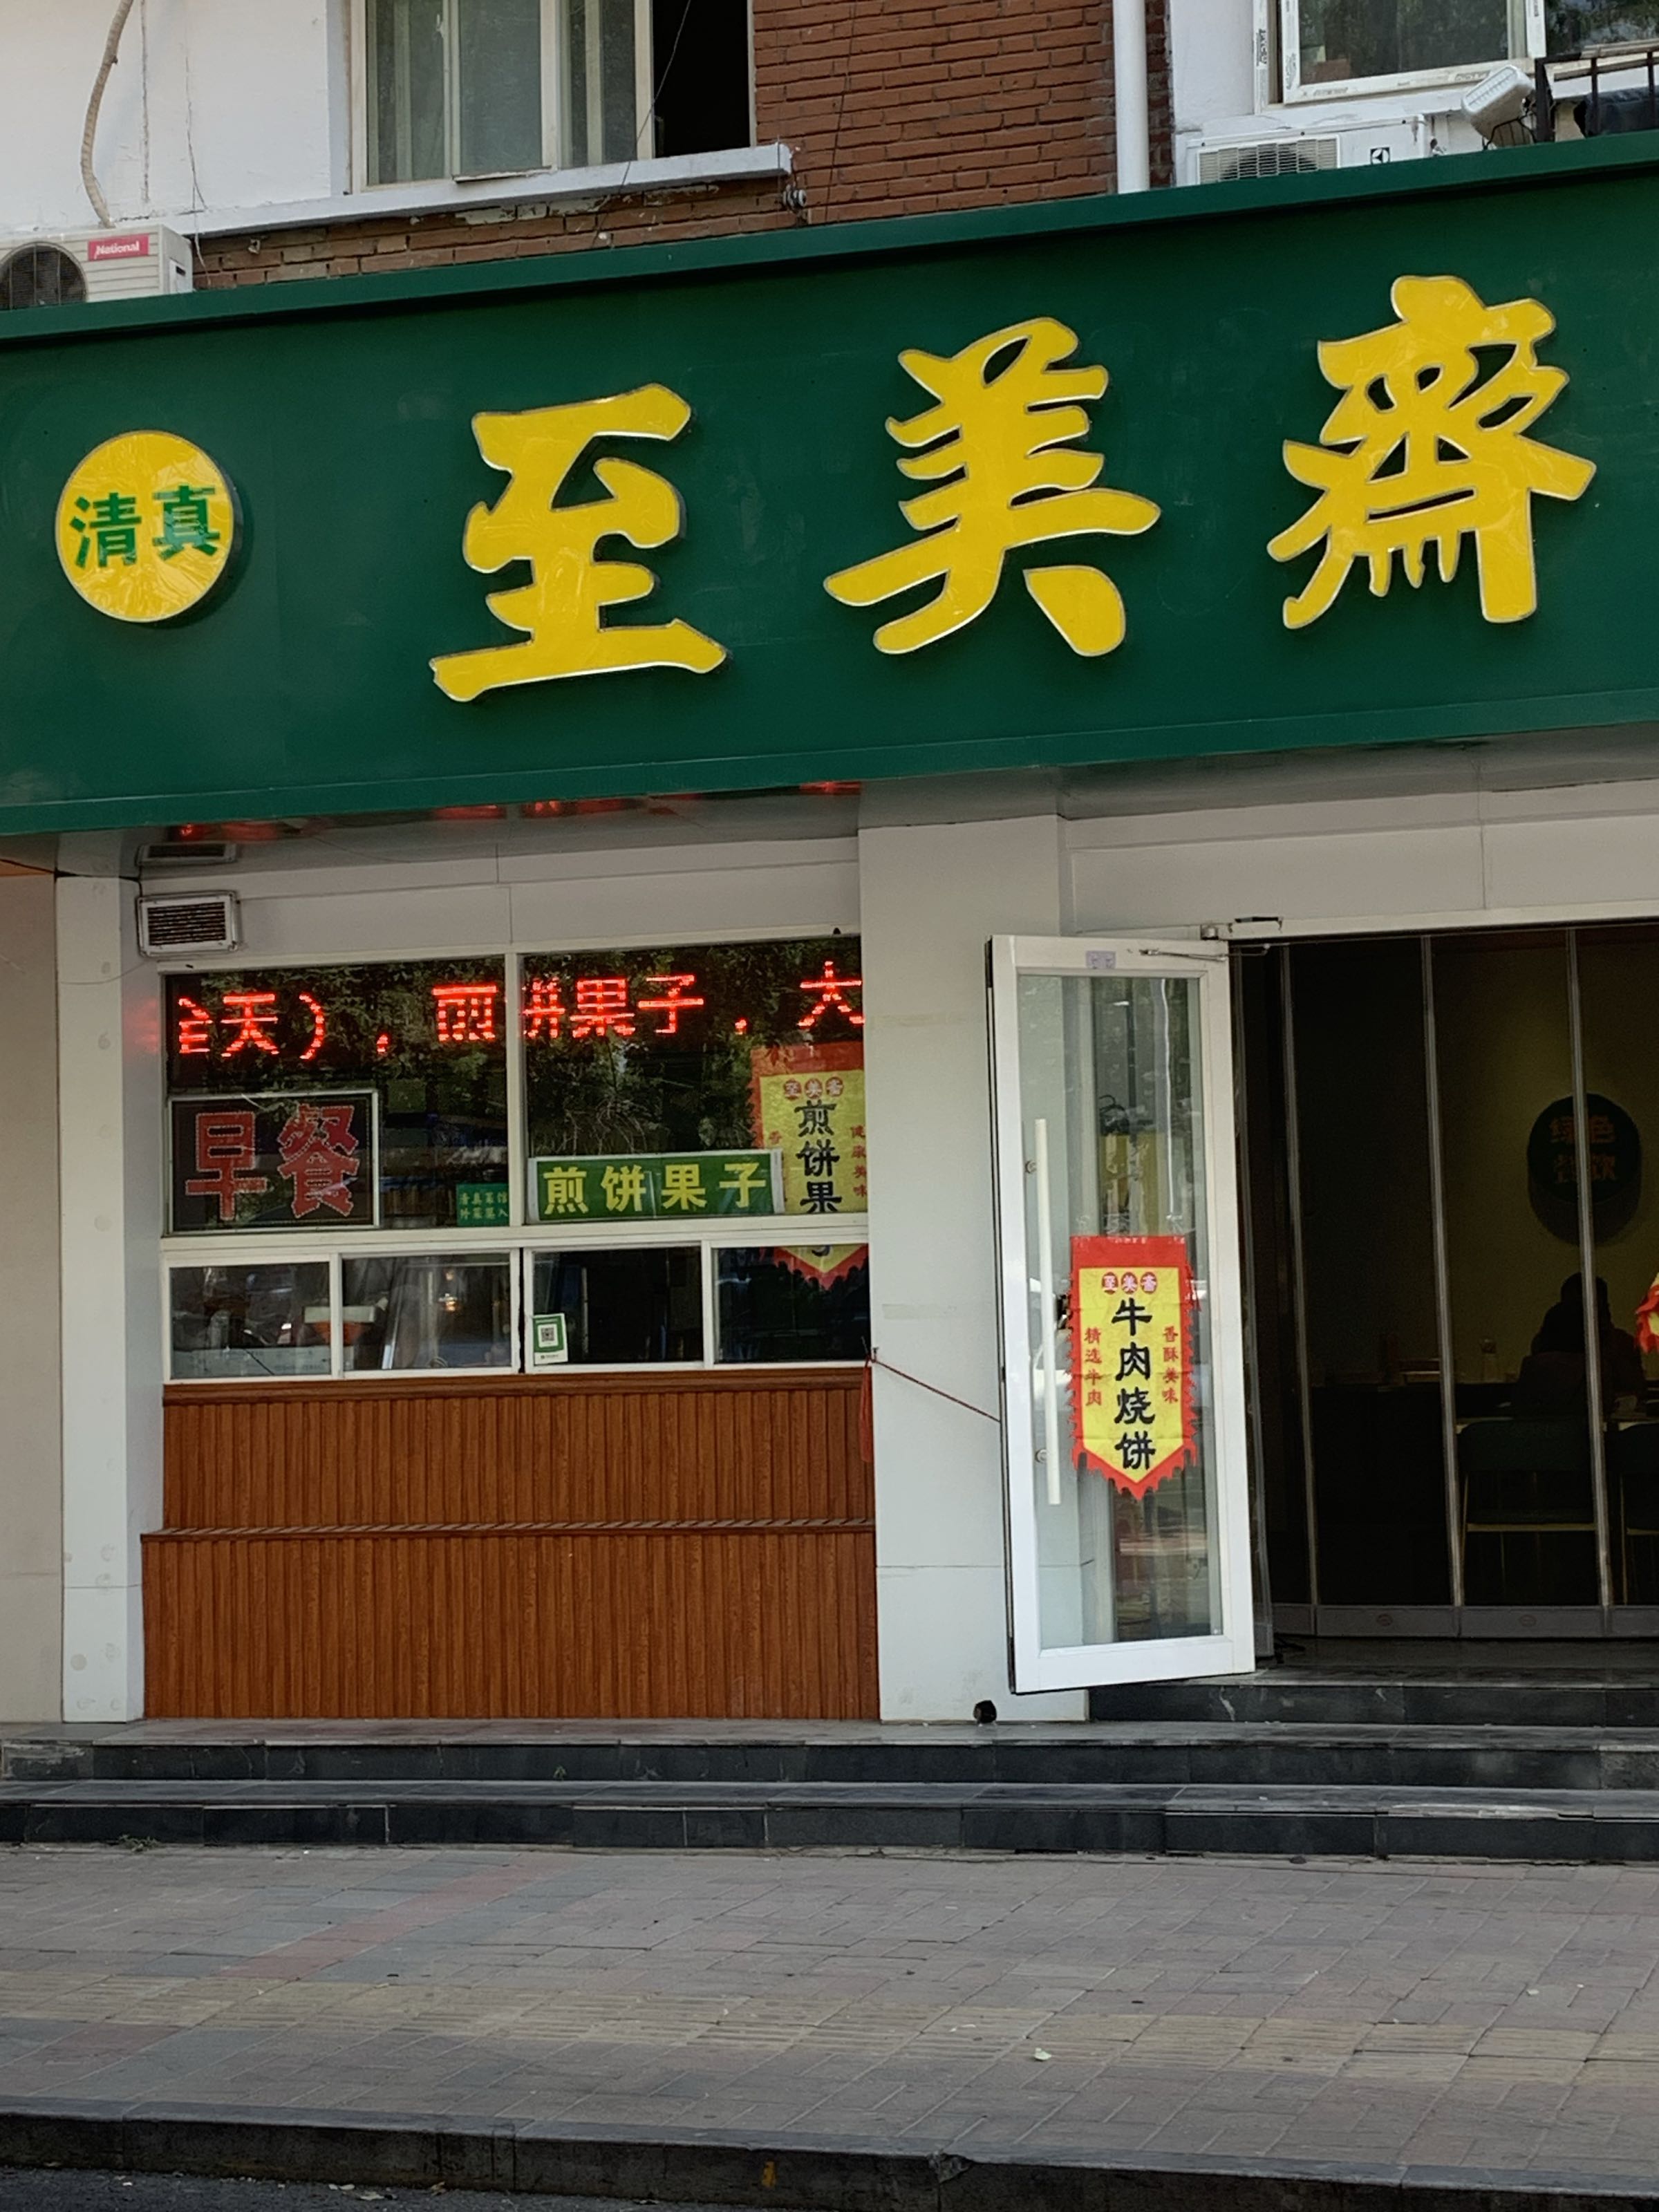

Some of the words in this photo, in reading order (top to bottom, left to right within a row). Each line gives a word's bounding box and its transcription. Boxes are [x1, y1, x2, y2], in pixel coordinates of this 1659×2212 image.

[94, 240, 140, 260] National
[71, 485, 219, 568] 清真
[185, 1103, 359, 1220] 早餐
[543, 1162, 766, 1215] 煎饼果子
[794, 1099, 843, 1257] 煎饼果
[1084, 1327, 1103, 1407] 精选牛肉
[1112, 1297, 1156, 1470] 牛肉烧饼
[1162, 1326, 1179, 1404] 香酥美味
